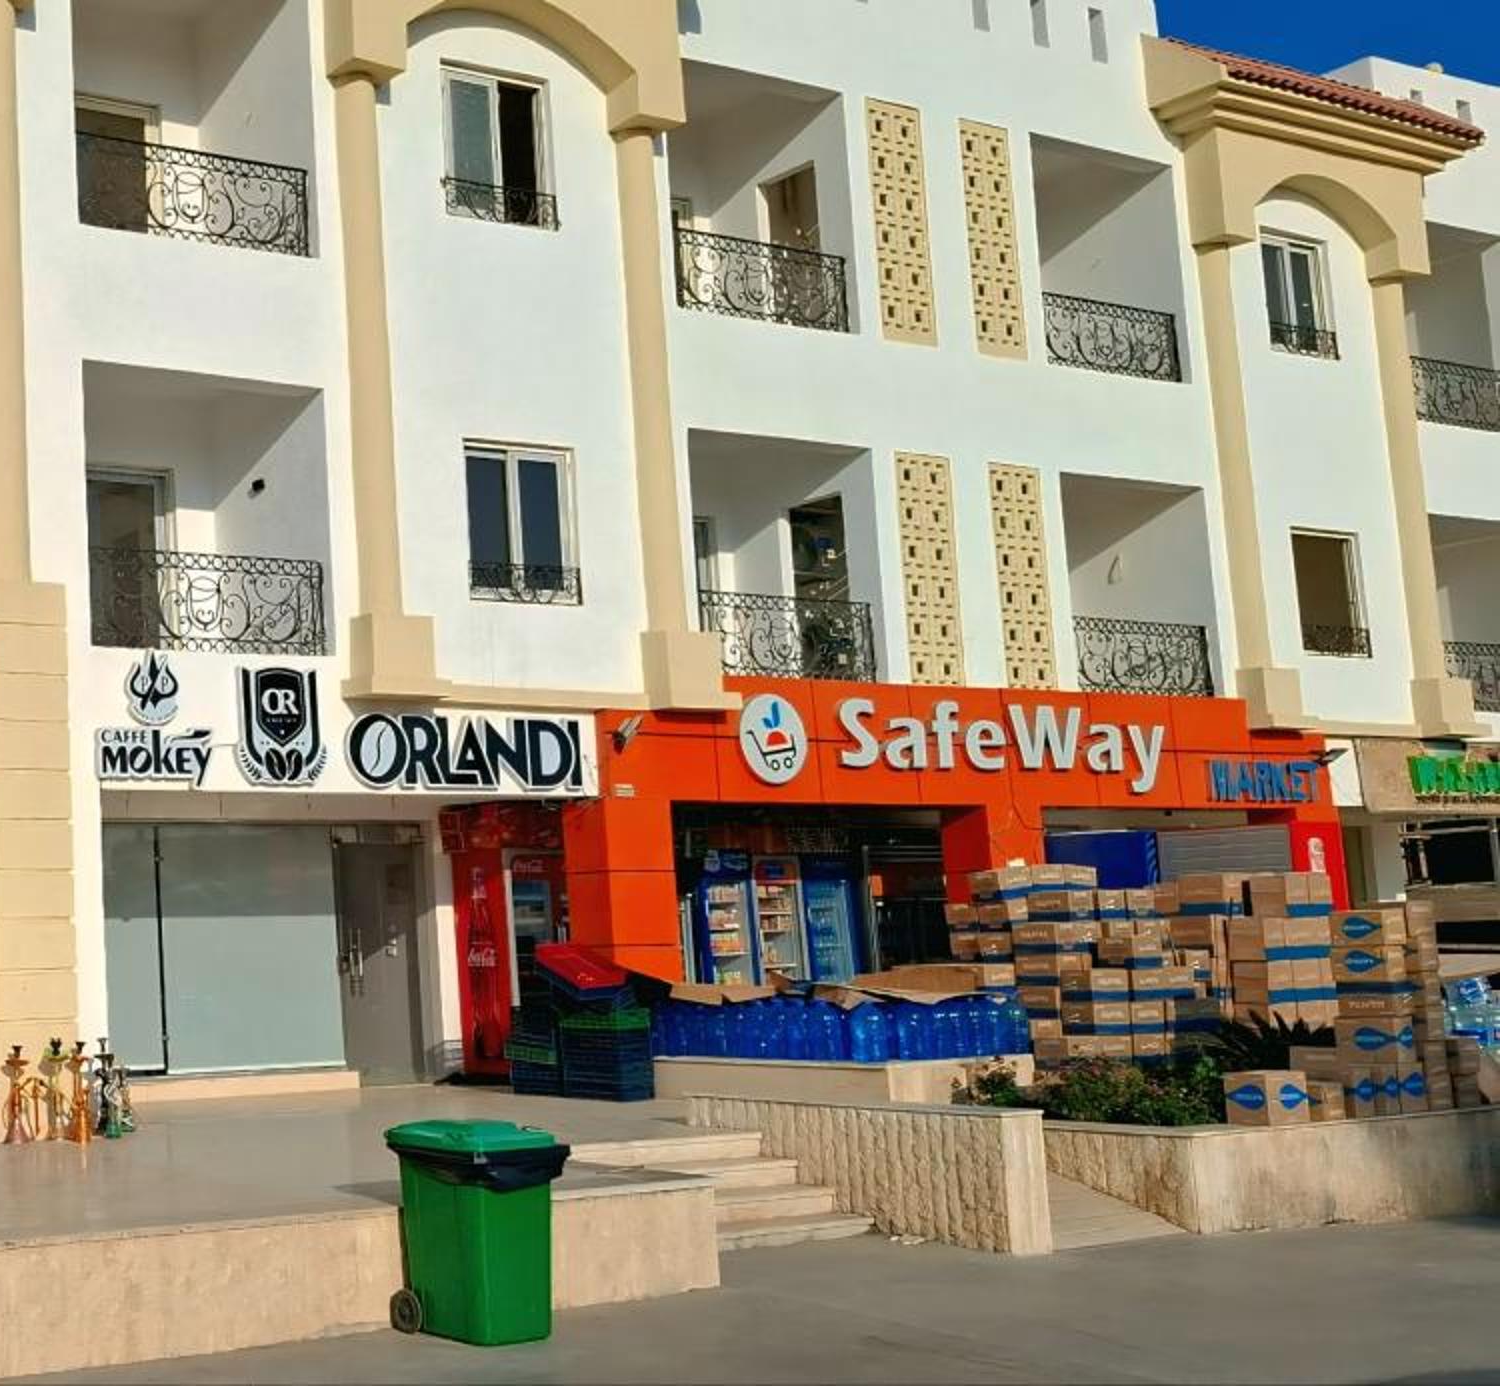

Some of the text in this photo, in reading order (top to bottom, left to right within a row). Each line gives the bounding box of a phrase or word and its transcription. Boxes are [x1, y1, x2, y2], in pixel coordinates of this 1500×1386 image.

[261, 688, 299, 715] OR
[348, 712, 586, 787] ORLANDI
[838, 697, 1165, 793] SafeWay
[1208, 760, 1318, 802] MARKET
